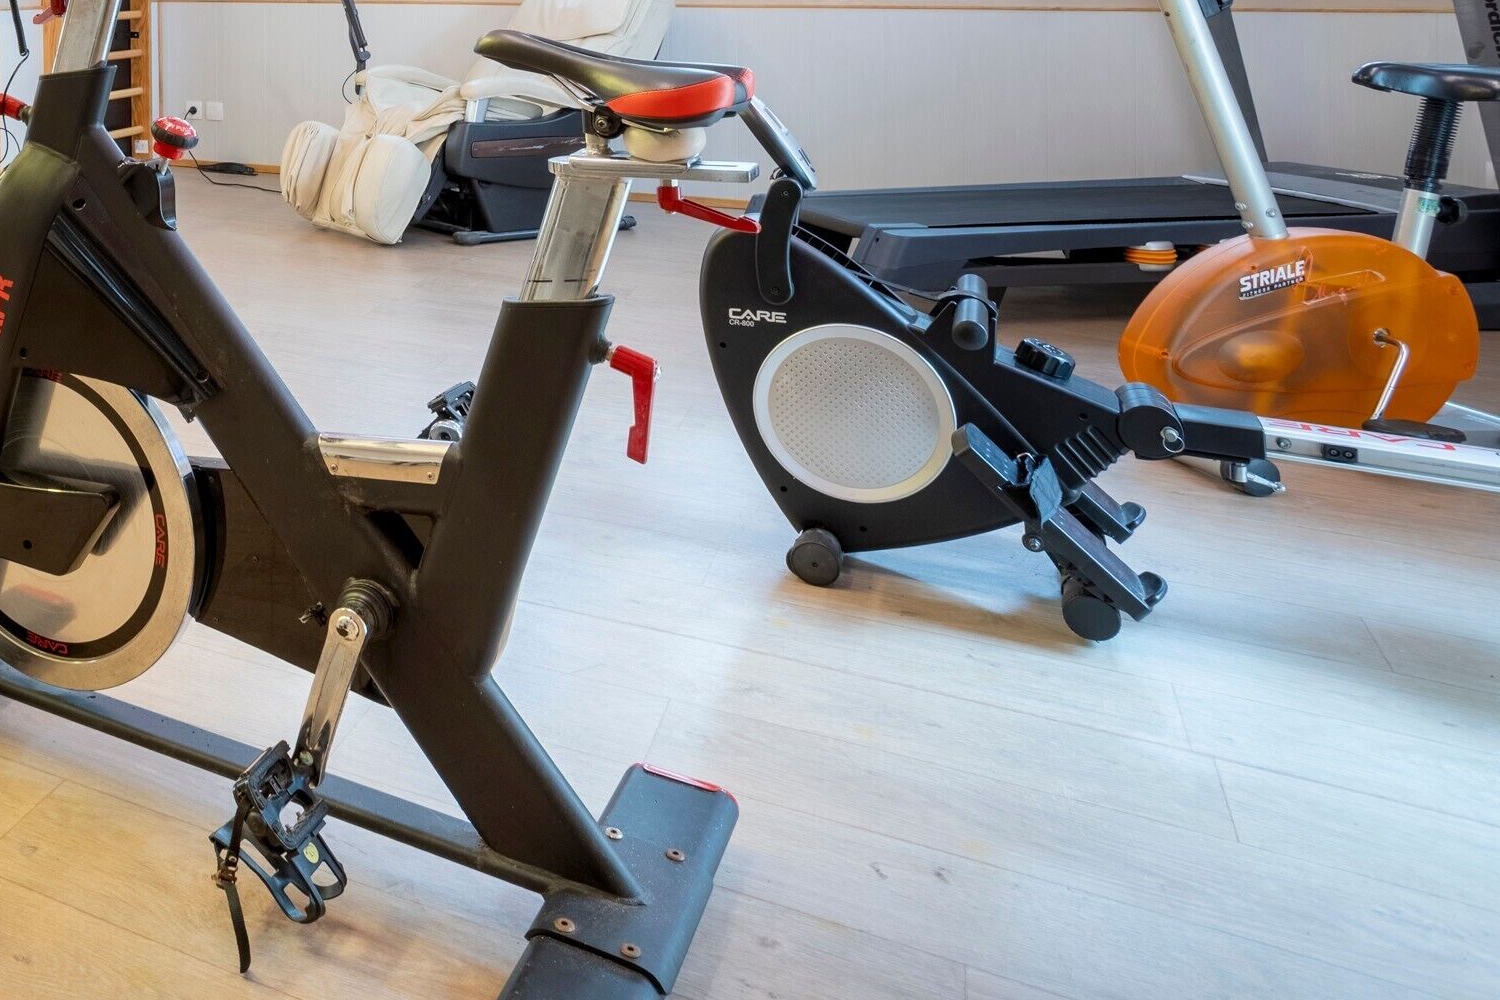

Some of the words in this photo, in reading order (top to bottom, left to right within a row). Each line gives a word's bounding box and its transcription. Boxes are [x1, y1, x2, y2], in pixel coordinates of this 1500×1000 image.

[1239, 260, 1305, 293] STRIALE
[1242, 286, 1271, 298] FITNESS
[1273, 276, 1305, 289] PARTNER
[728, 308, 787, 324] CARE
[728, 319, 755, 327] CR-800
[155, 513, 166, 568] CARE
[26, 631, 68, 655] CARE
